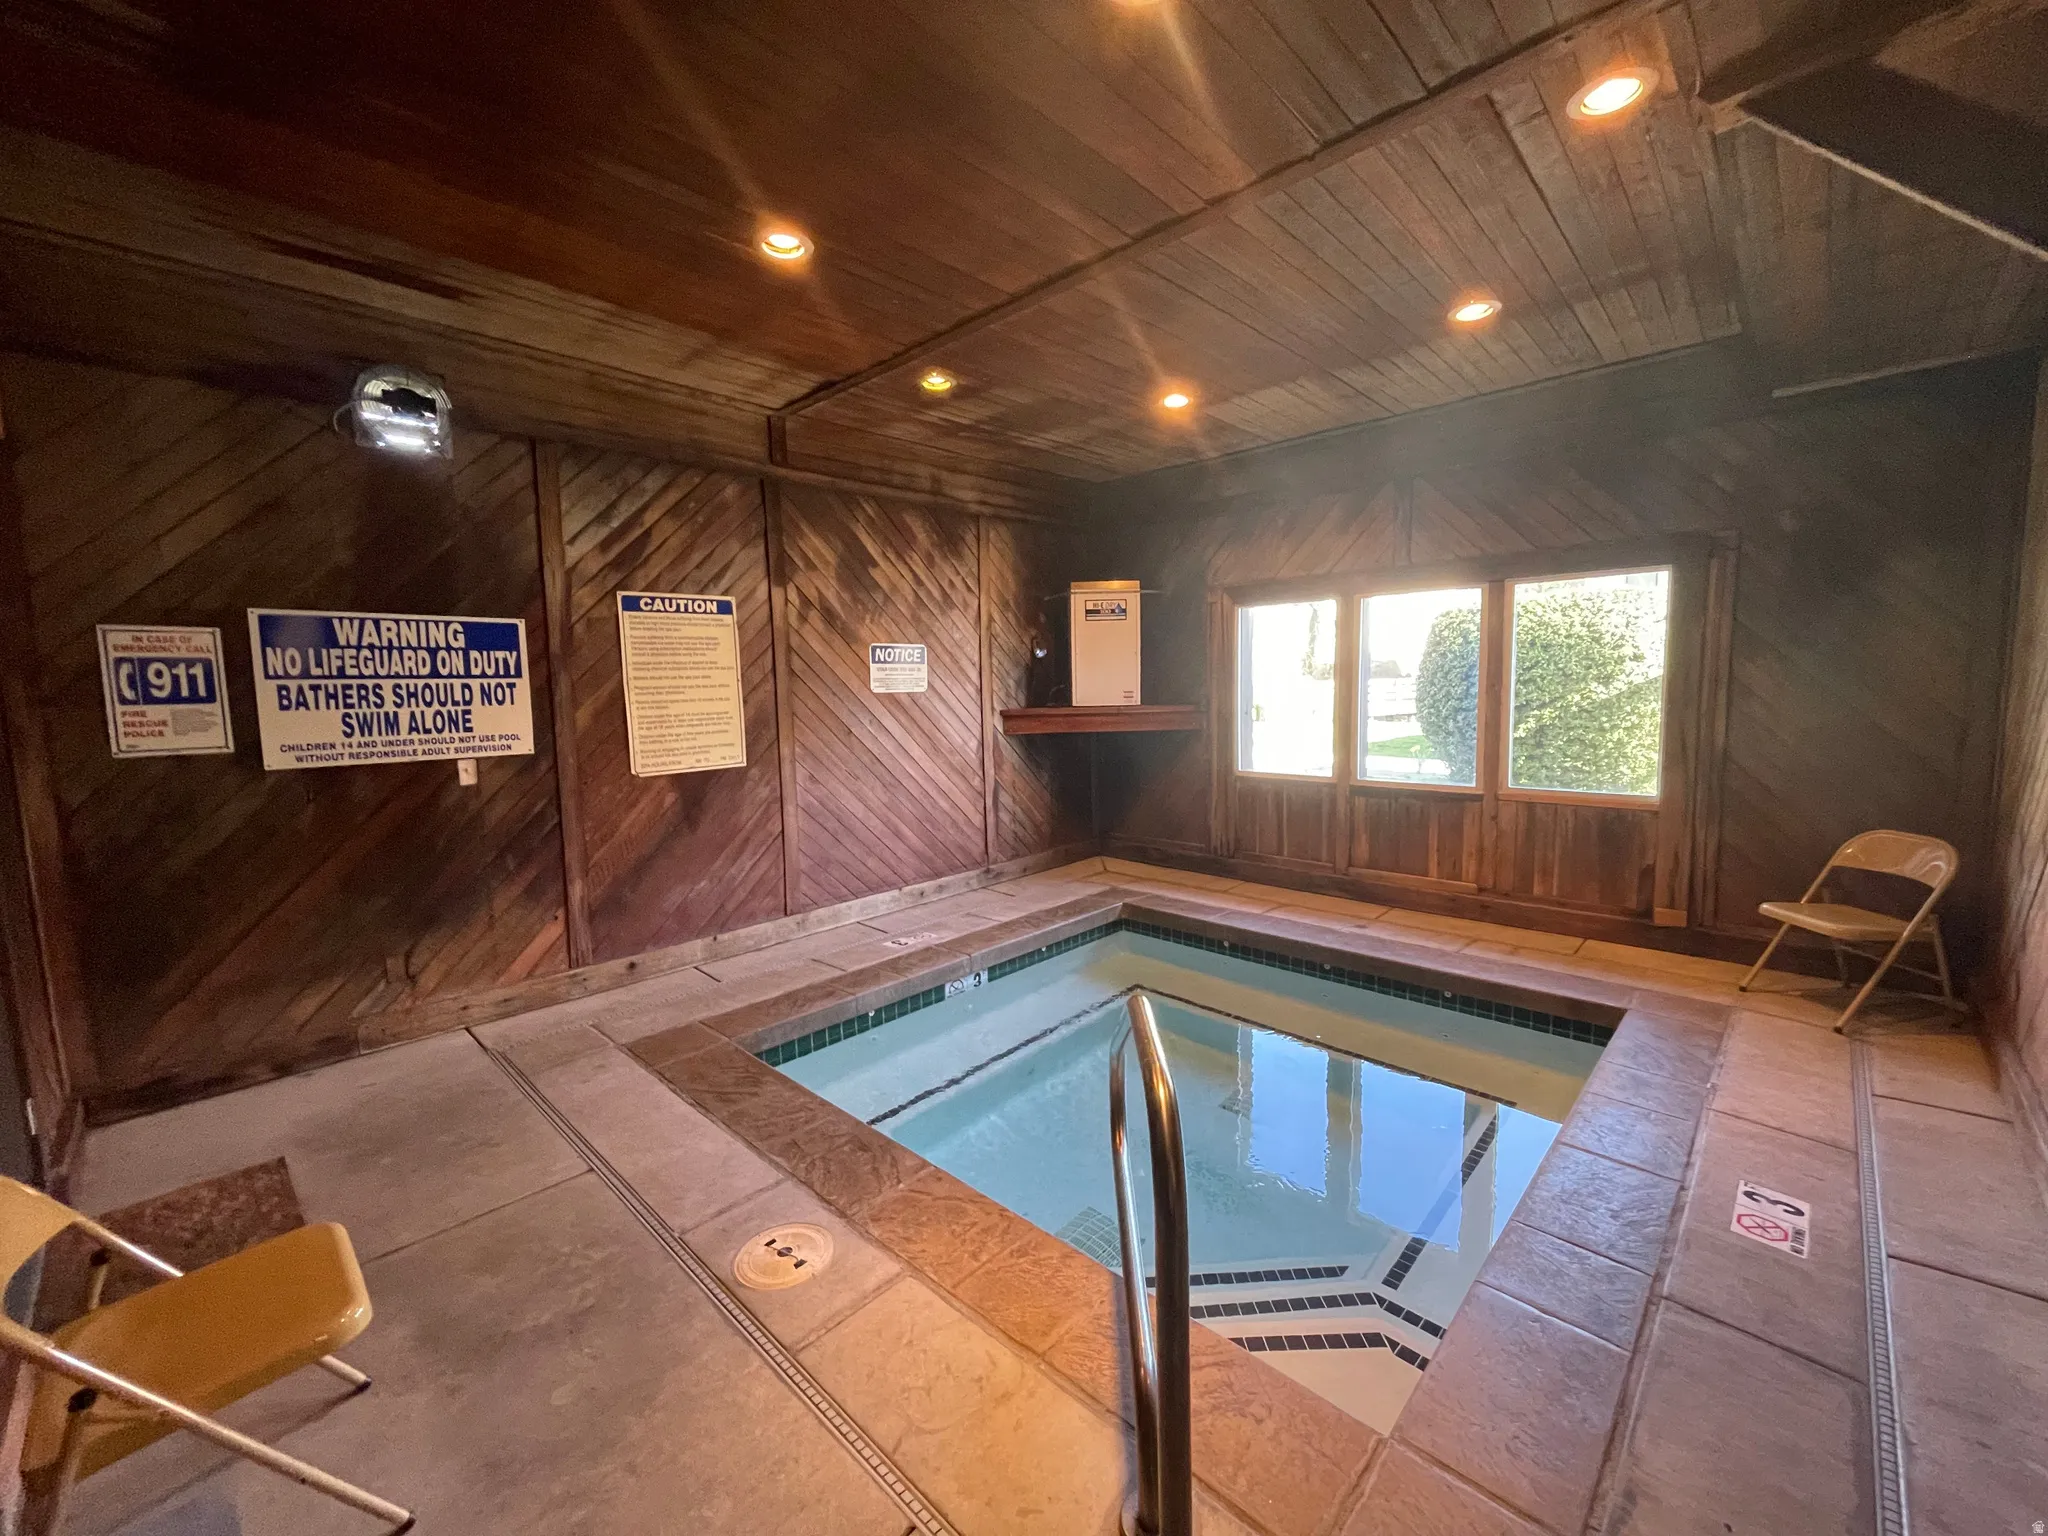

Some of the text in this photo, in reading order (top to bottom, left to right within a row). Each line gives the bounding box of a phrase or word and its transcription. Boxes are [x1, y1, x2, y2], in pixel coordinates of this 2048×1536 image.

[640, 597, 718, 613] CAUTION
[131, 635, 192, 644] IN CASE OF
[332, 618, 466, 648] WARNING
[112, 644, 212, 653] EMERGENCY CALL
[875, 648, 922, 662] NOTICE
[266, 647, 517, 676] NO LIFEGUARD ON DUTY
[147, 661, 207, 698] 911
[276, 682, 516, 711] BATHERS SHOULD NOT
[122, 720, 168, 729] RESCUE
[341, 709, 474, 738] SWIM ALONE
[123, 729, 164, 738] POLICE
[280, 733, 521, 753] CHILDREN 14 AND UNDER SHOULD NOT USE POOL
[295, 744, 512, 763] WITHOUT RESPONSIBLE ADULT SUPERVISION
[973, 972, 982, 987] 3
[1742, 1190, 1805, 1217] 3
